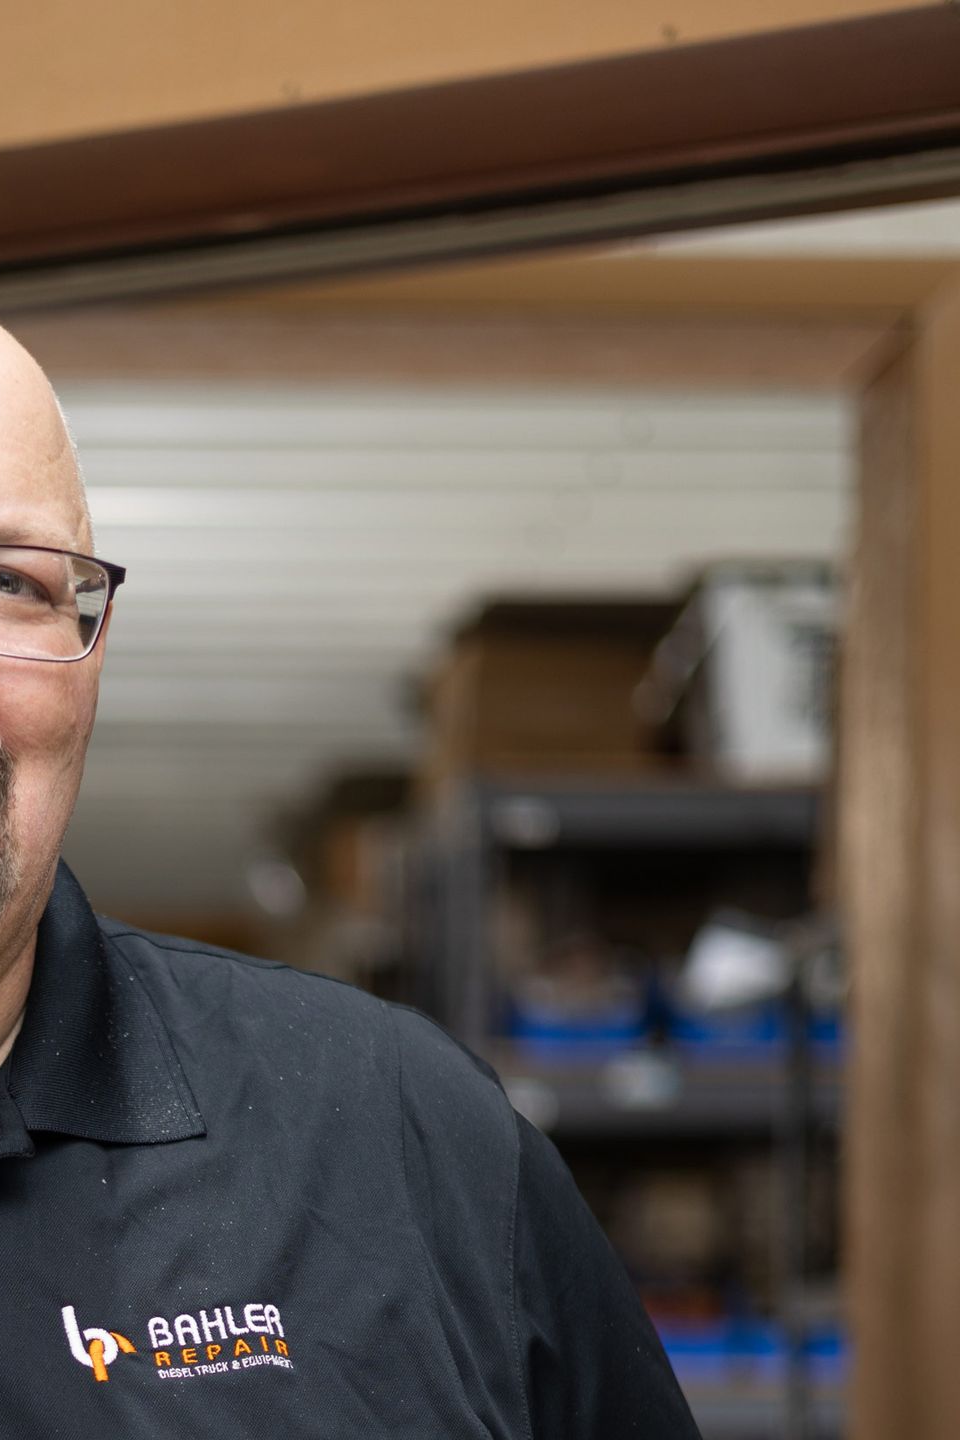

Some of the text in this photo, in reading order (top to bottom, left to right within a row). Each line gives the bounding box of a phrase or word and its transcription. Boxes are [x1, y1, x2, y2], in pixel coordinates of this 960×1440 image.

[147, 1303, 284, 1348] BAHLER
[155, 1336, 290, 1367] REPAIR
[158, 1368, 195, 1379] DIESEL
[195, 1362, 229, 1376] TRUCK
[231, 1360, 241, 1370] &
